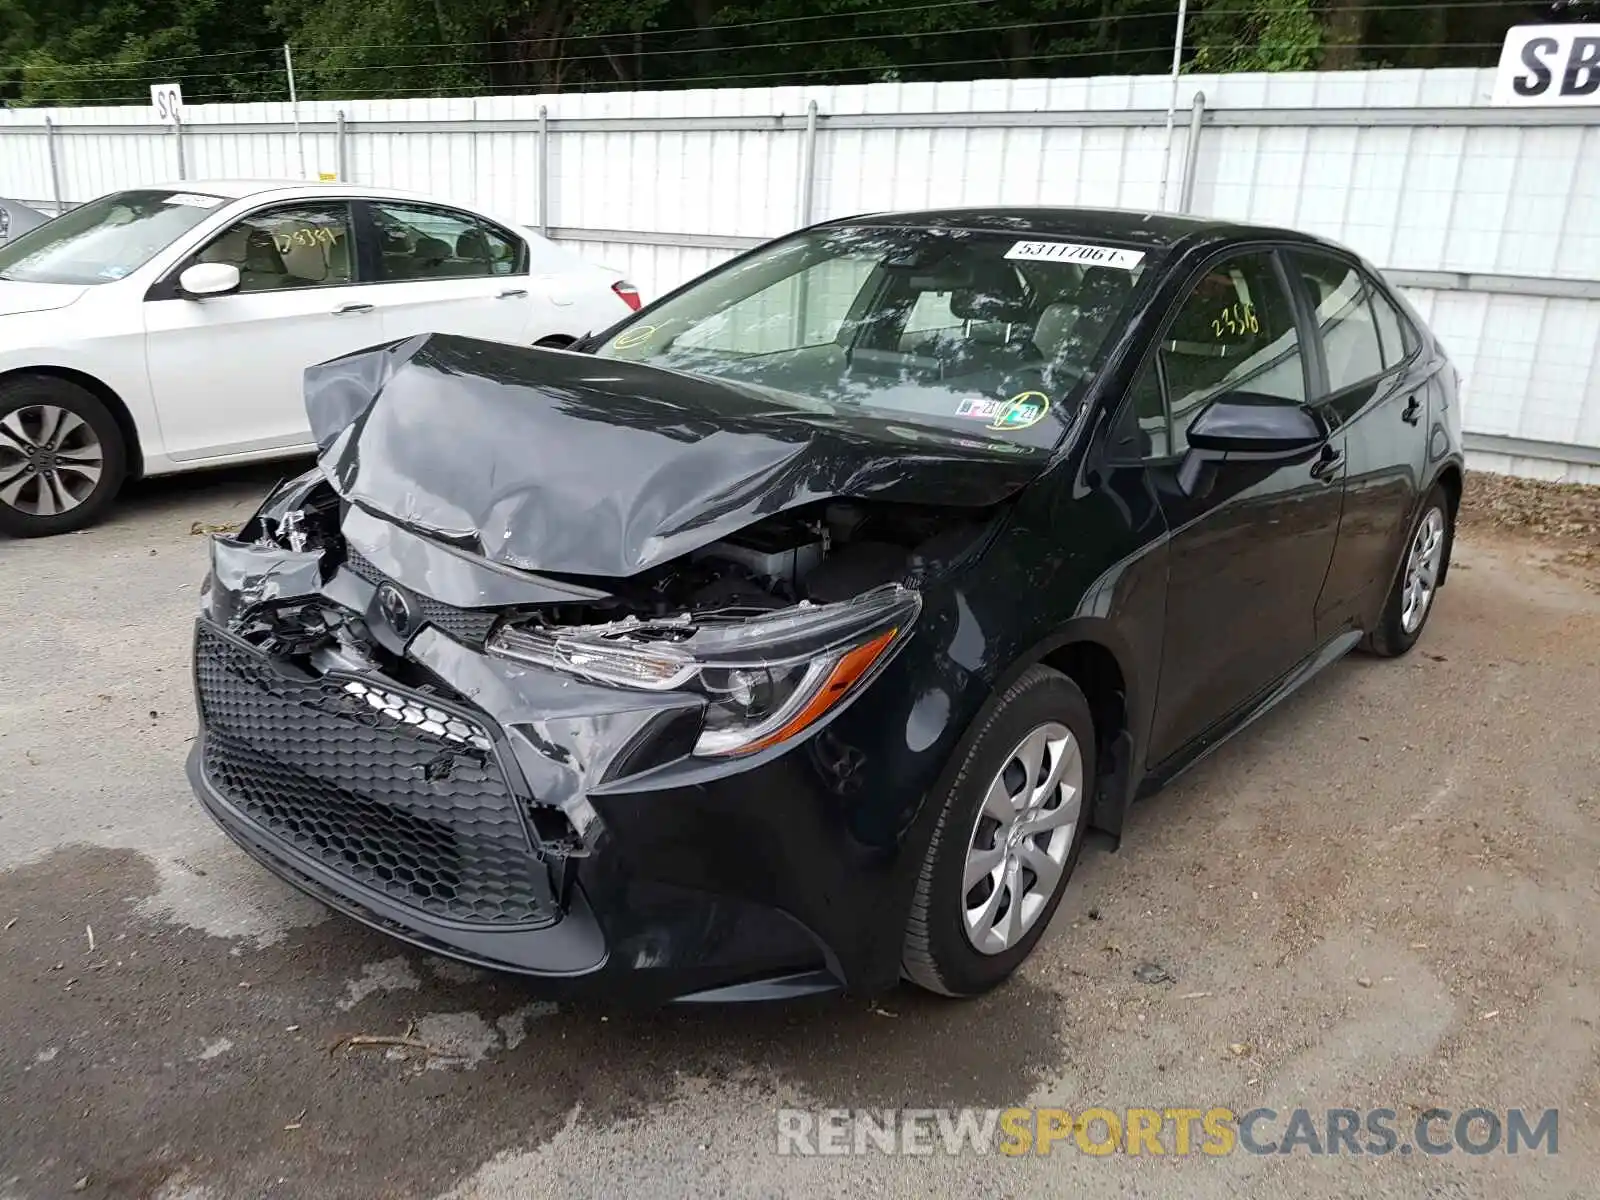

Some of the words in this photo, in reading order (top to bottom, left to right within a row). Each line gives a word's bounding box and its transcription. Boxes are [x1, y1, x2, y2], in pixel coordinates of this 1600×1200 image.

[1513, 37, 1600, 96] SB
[158, 90, 181, 122] SC
[1018, 243, 1118, 262] 53117061
